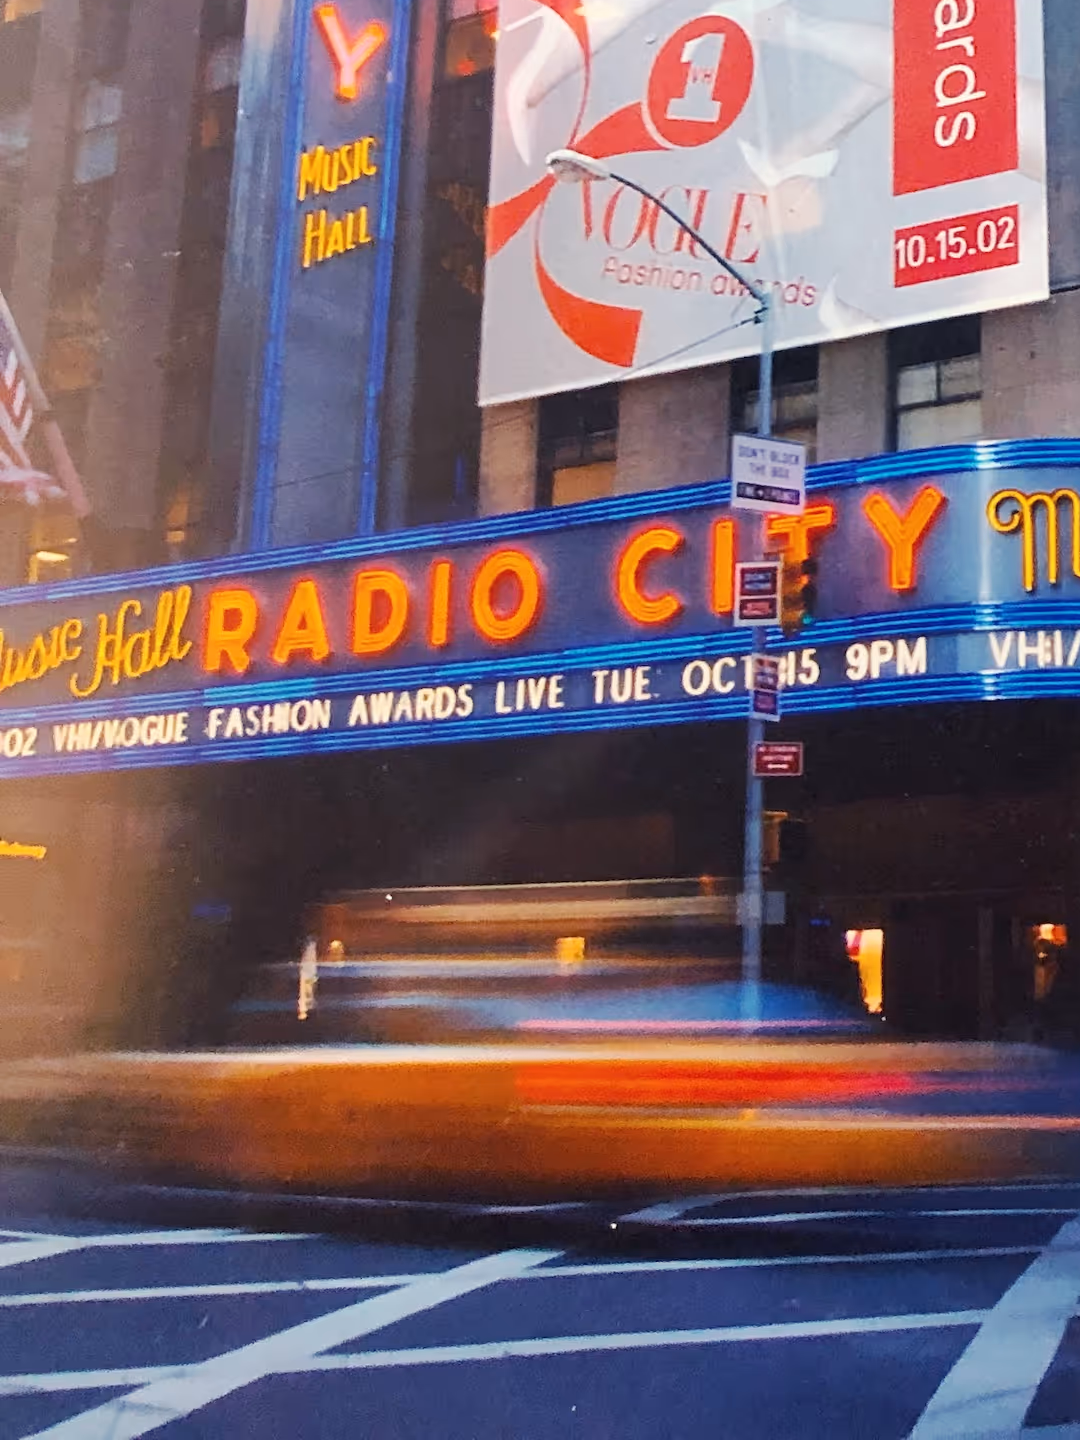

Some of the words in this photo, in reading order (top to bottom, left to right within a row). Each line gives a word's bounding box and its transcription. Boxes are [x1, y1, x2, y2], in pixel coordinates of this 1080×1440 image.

[297, 135, 378, 202] MUSIC
[302, 206, 372, 268] HALL
[896, 216, 1016, 269] 10.15.02
[0, 619, 82, 692] usic
[70, 585, 192, 696] Hall
[202, 546, 543, 673] RADIO
[616, 485, 946, 624] CITY
[206, 698, 331, 740] FASHION
[348, 683, 474, 728] AWARDS
[495, 674, 565, 714] LIVE
[846, 637, 928, 682] 9PM
